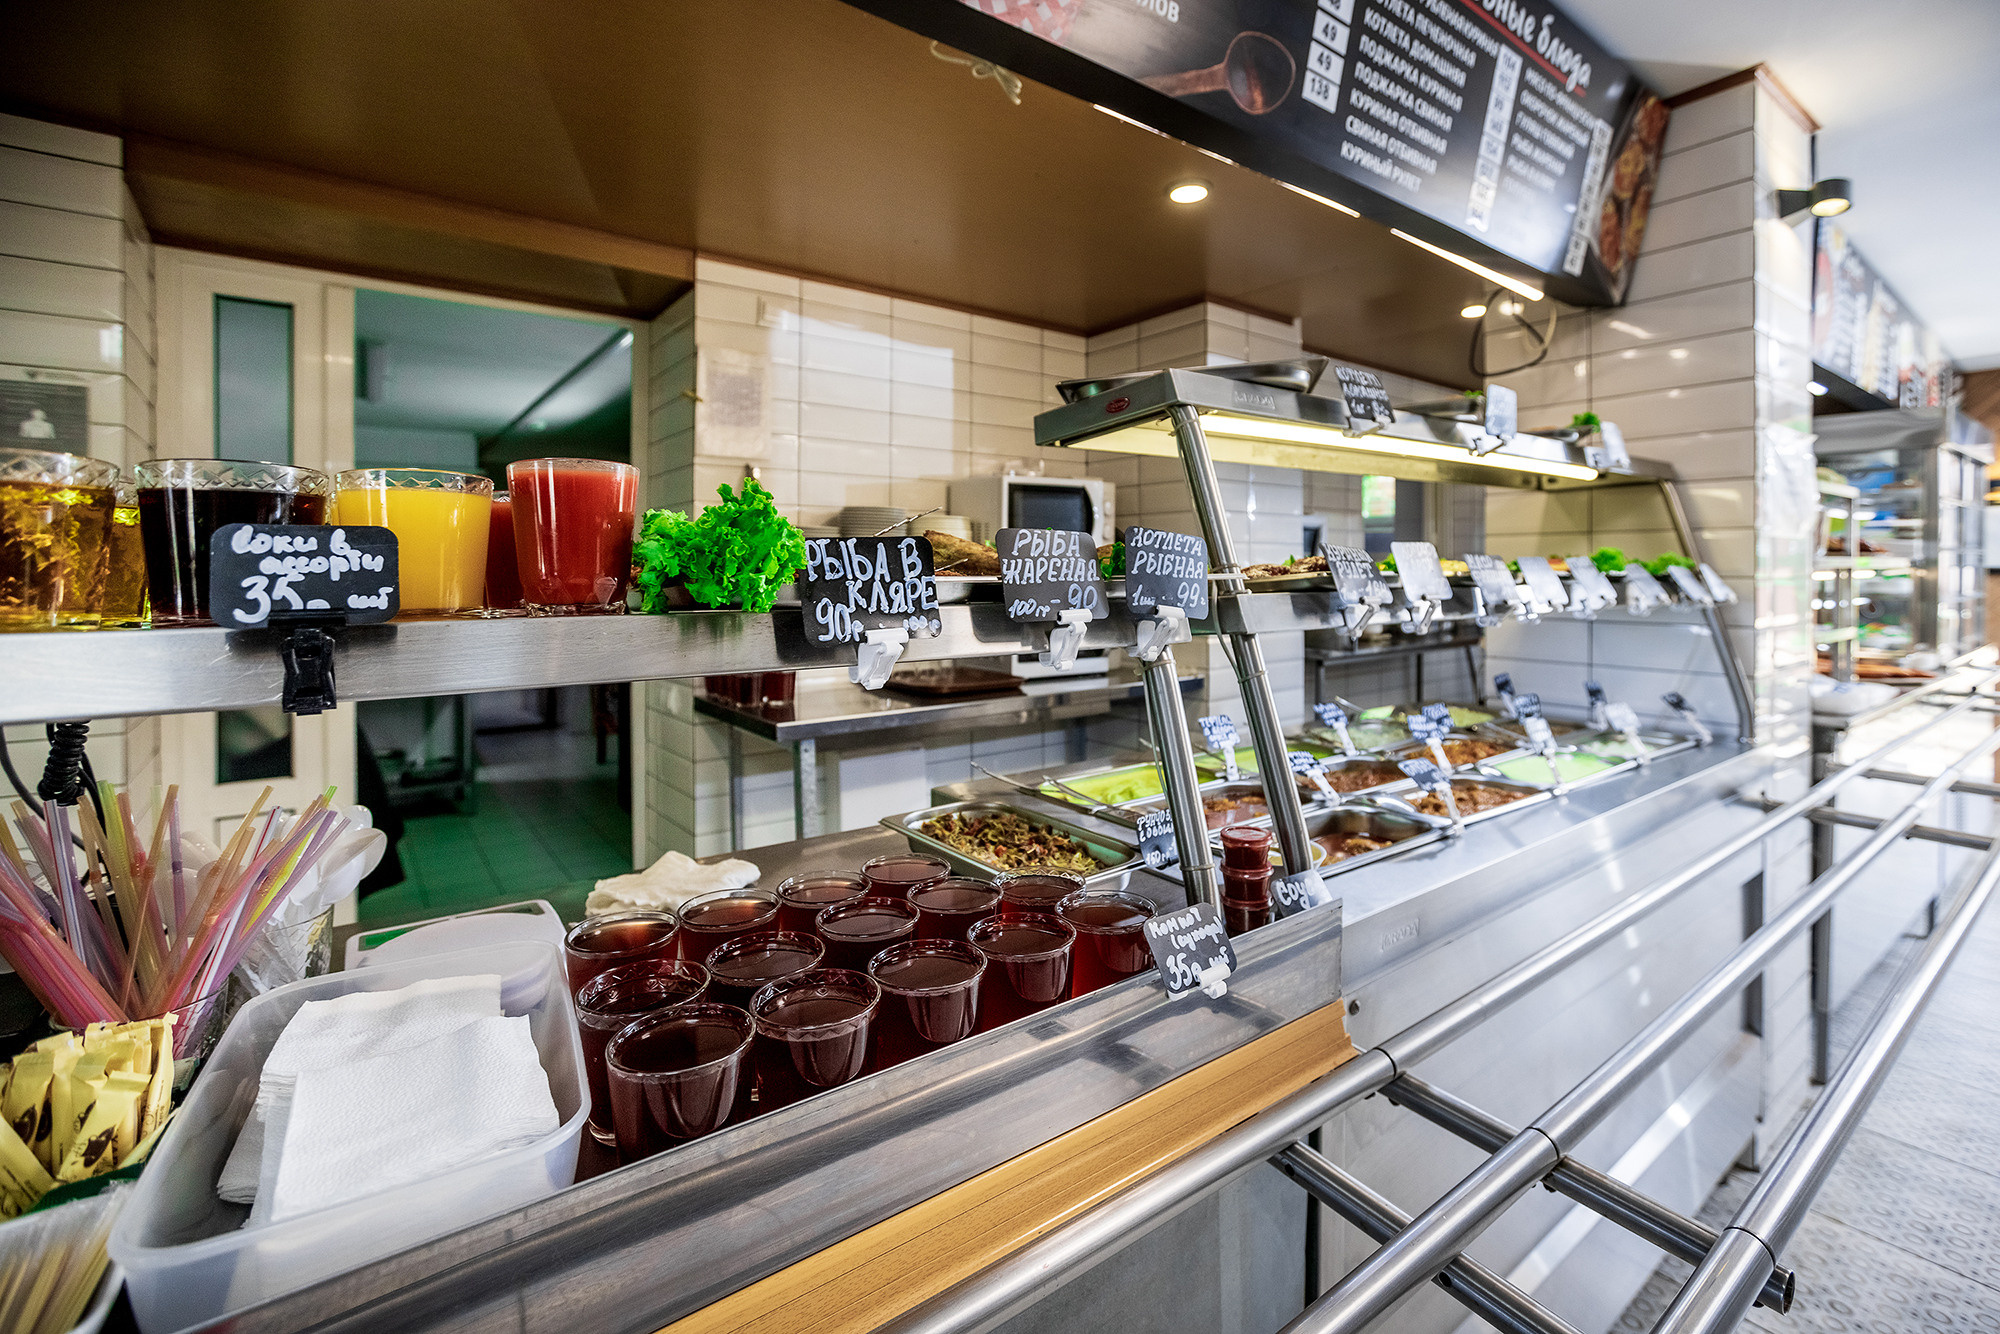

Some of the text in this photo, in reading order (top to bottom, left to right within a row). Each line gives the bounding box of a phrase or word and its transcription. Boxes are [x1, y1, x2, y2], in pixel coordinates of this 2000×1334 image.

[1322, 22, 1337, 41] 49
[1363, 6, 1411, 53] КОТЛЕТА
[1358, 33, 1464, 113] ПОДЖАРКА КУРИНАЯ
[1537, 14, 1591, 93] блюда
[1349, 87, 1400, 129] КУРИНАЯ
[1354, 60, 1454, 133] ПОДЖАРКА СВИНАЯ
[1345, 114, 1389, 151] СВИНАЯ
[1340, 140, 1393, 180] КУРИНЫЙ
[805, 537, 923, 582] РЫБА В
[1011, 528, 1082, 558] РЫБА
[1130, 527, 1202, 557] КОТЛЕТА
[1002, 557, 1101, 585] ЖАРЕНАЯ
[1131, 550, 1205, 580] РЫБНАЯ
[845, 575, 940, 614] КЛЯРЕ
